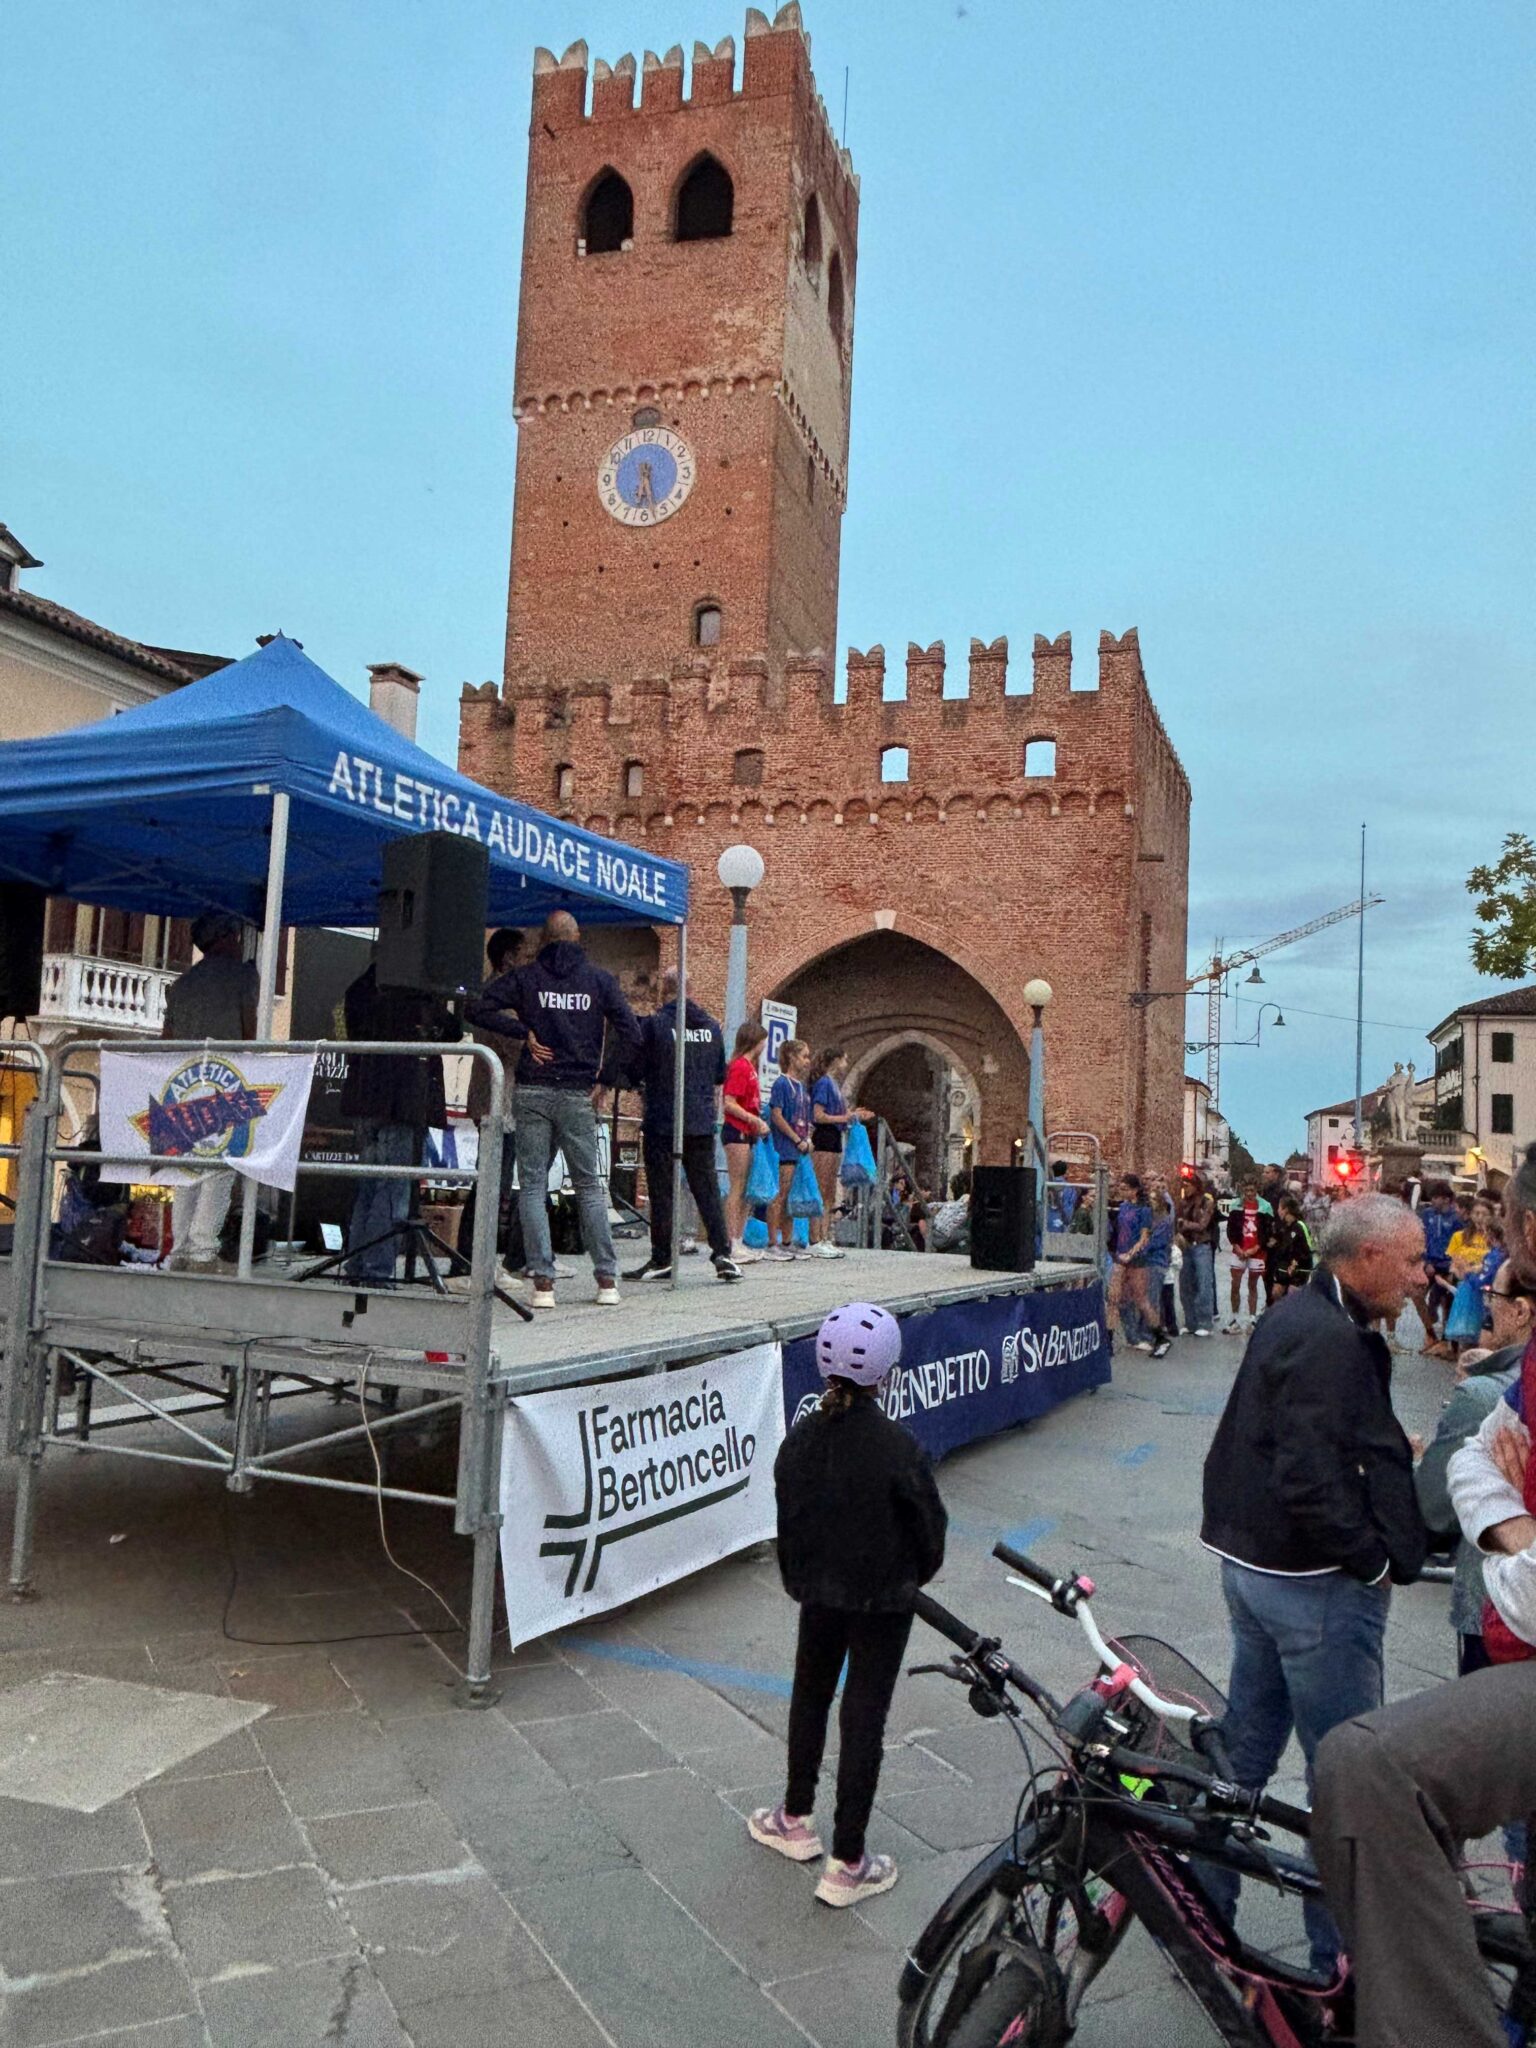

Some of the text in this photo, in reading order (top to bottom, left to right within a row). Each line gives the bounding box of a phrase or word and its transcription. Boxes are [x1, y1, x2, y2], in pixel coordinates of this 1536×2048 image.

[643, 430, 655, 444] 12
[624, 438, 632, 450] 11
[677, 446, 686, 457] 2
[610, 452, 621, 464] 10
[682, 467, 691, 479] 3
[603, 474, 611, 486] 9
[608, 494, 616, 506] 8
[674, 488, 682, 500] 4
[623, 508, 631, 520] 7
[660, 503, 668, 516] 5
[641, 510, 649, 522] 6
[328, 750, 667, 908] ATLETICA AUDACE NOALE
[538, 991, 591, 1011] VENETO
[671, 1028, 713, 1043] VNETO
[171, 1062, 241, 1100] ATLETICA
[886, 1348, 990, 1422] BENEDETTO
[597, 1425, 756, 1521] Bertoncello
